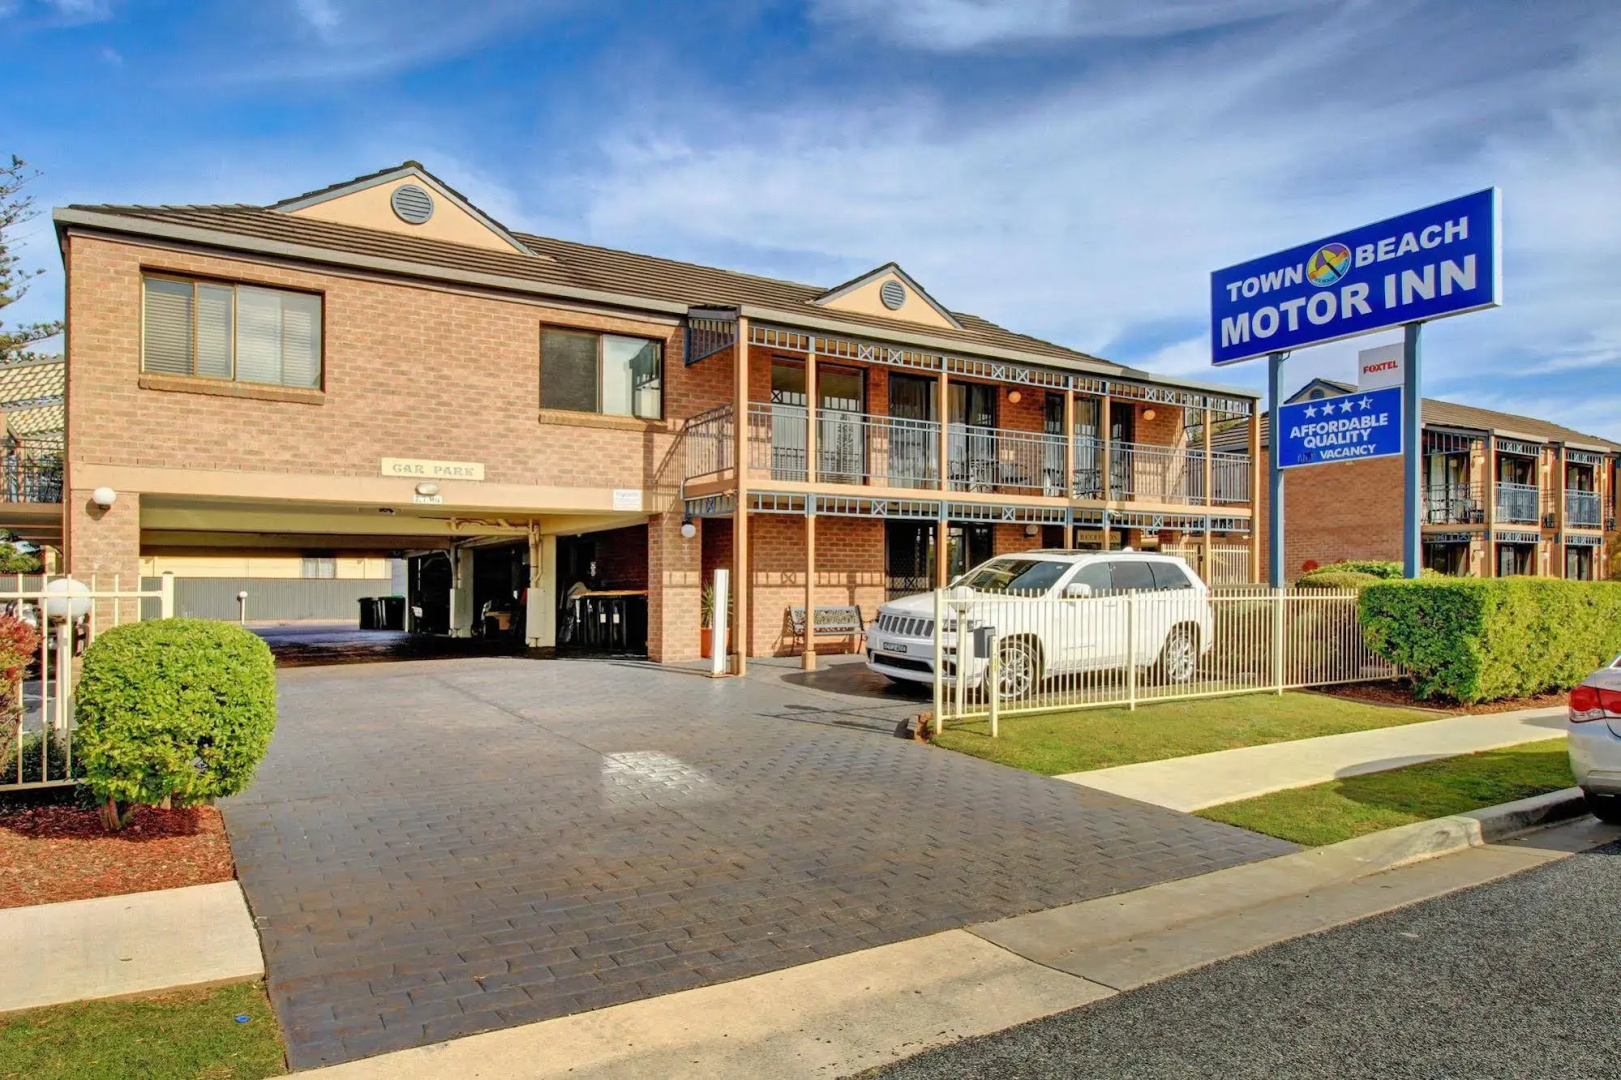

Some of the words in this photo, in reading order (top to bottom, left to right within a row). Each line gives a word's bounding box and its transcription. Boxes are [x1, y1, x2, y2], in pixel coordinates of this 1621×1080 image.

[1226, 263, 1304, 302] TOWN
[1355, 216, 1469, 269] BEACH
[1220, 281, 1373, 348] MOTOR
[1384, 254, 1477, 310] INN
[1363, 360, 1399, 374] FOXTEL
[1289, 412, 1389, 439] AFFORDABLE
[1303, 428, 1371, 449] QUALITY
[1320, 444, 1376, 460] VACANCY
[433, 465, 475, 477] PARK
